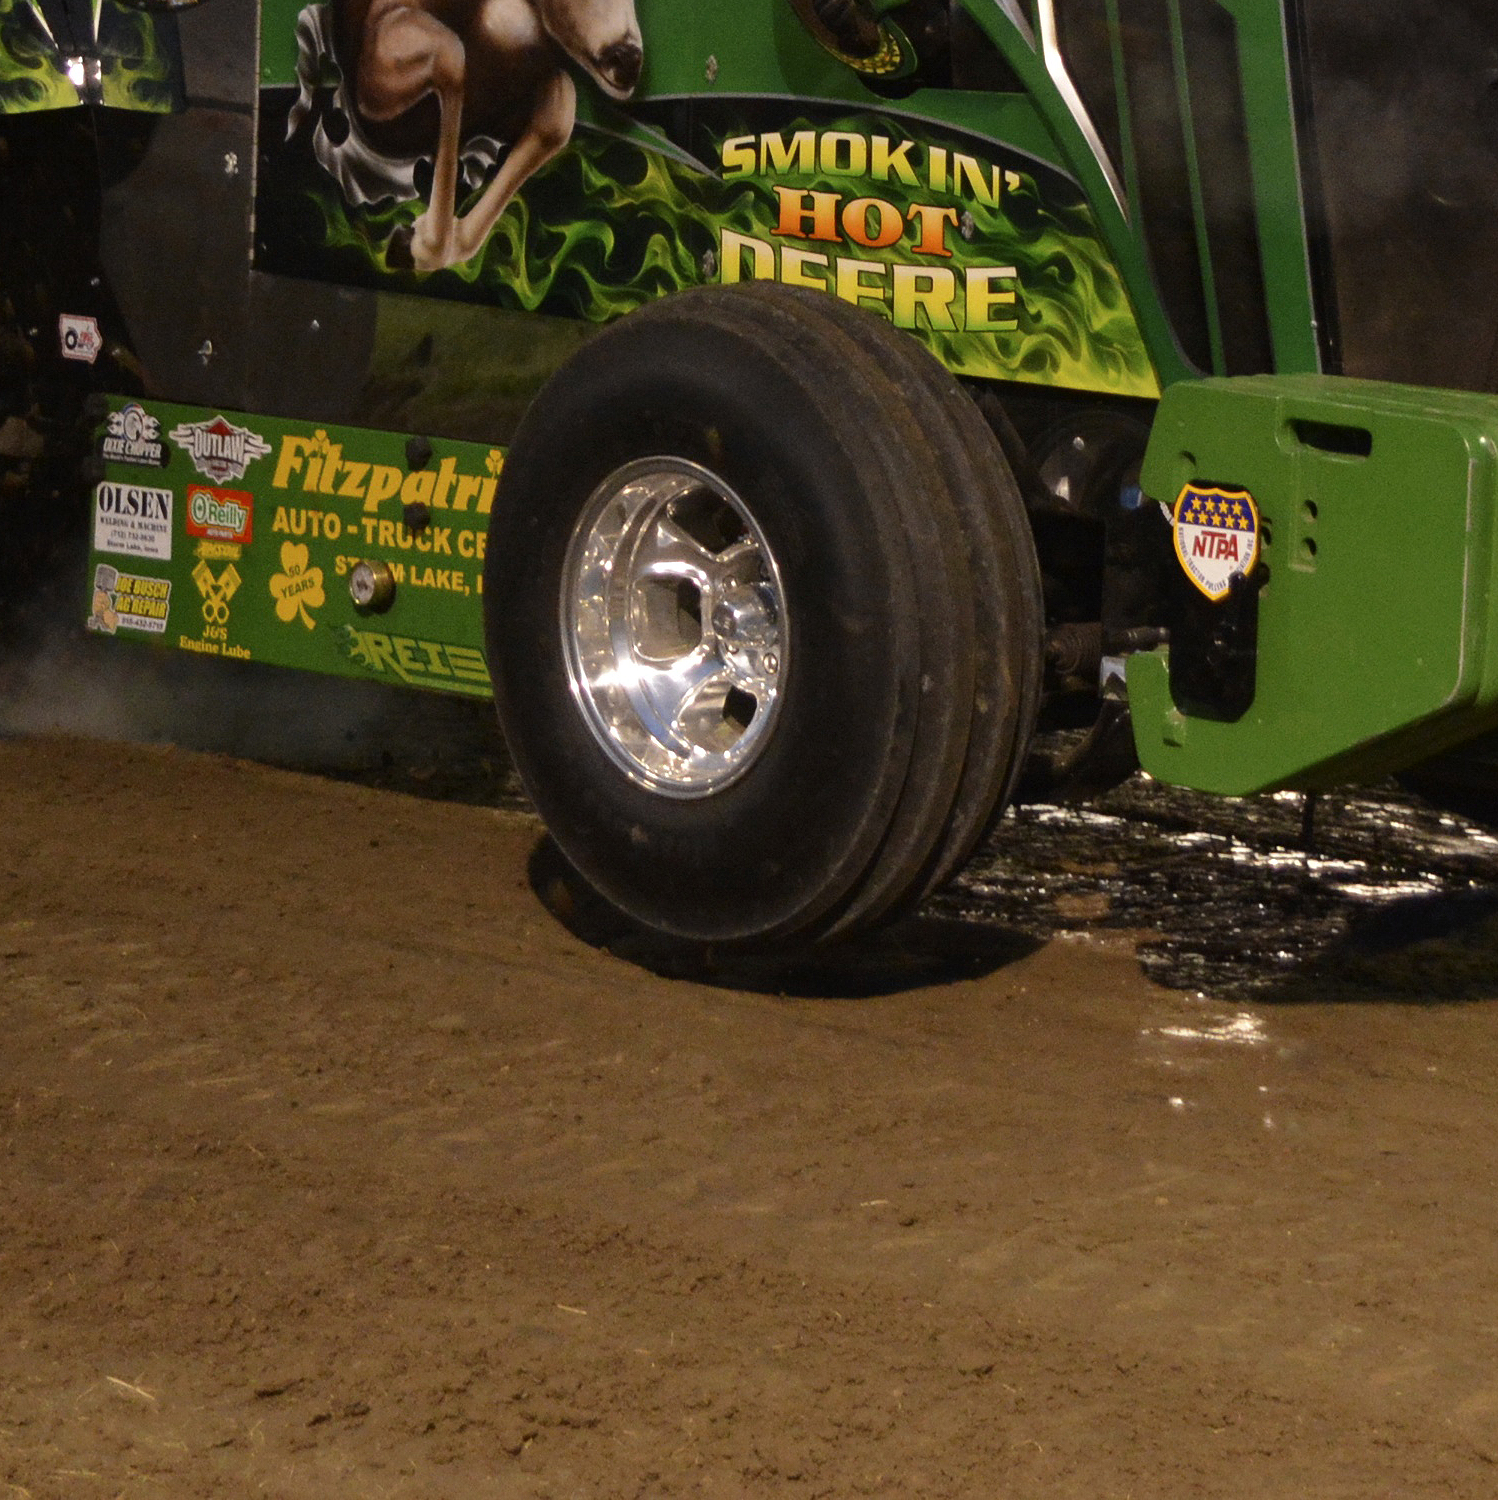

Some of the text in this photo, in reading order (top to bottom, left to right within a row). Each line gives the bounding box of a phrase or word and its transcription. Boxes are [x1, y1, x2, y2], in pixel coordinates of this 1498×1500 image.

[721, 130, 1020, 209] SMOKIN'
[770, 185, 960, 257] HOT
[720, 228, 1019, 332] DEERE
[193, 428, 245, 464] OUTLAW
[272, 429, 504, 514] Fitzpatri
[99, 485, 169, 520] OLSEN
[272, 506, 341, 540] AUTO
[362, 517, 452, 555] TRUCK
[1192, 529, 1239, 562] NTPA
[115, 577, 133, 594] JOE
[280, 578, 315, 600] YEARS
[410, 565, 470, 597] LAKE,
[1205, 578, 1227, 592] PULLIN
[115, 595, 168, 619] AG REPAIR
[180, 635, 251, 660] Engine Lube
